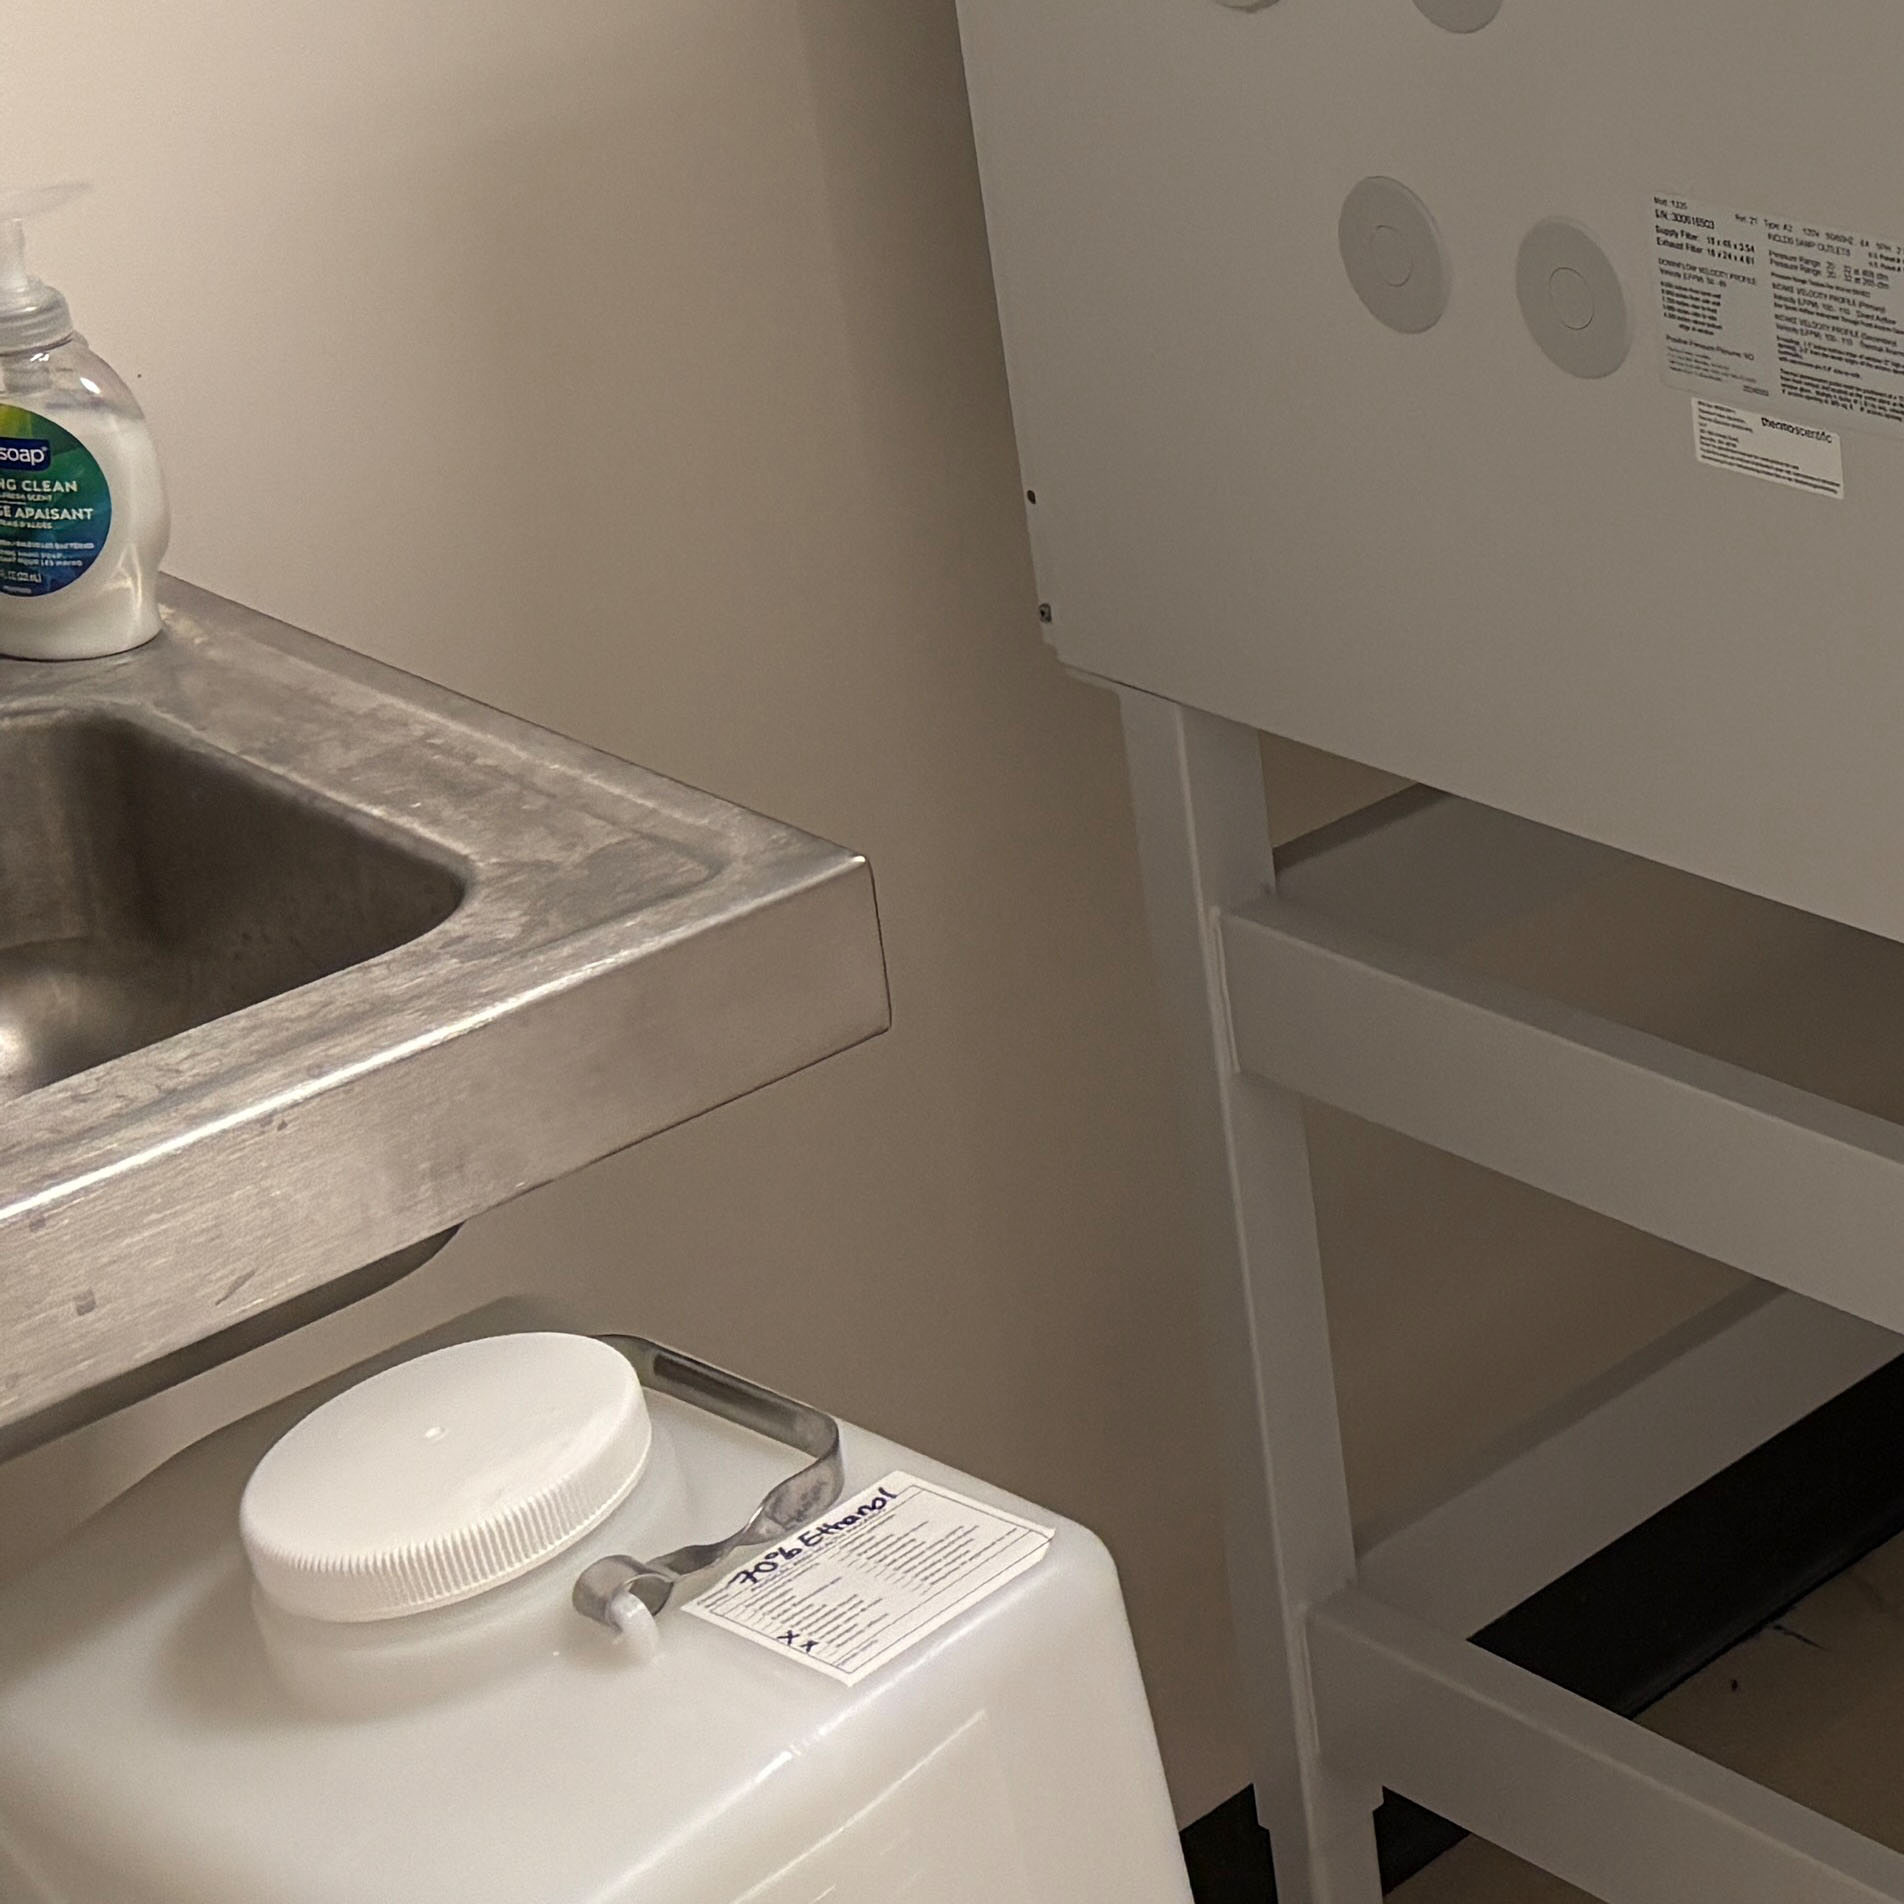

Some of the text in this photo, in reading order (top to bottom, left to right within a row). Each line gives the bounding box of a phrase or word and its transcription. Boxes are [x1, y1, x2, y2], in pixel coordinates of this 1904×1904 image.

[21, 480, 78, 493] CLEAN
[15, 507, 95, 520] APAISANT
[727, 1486, 899, 1586] 70% Ethanol
